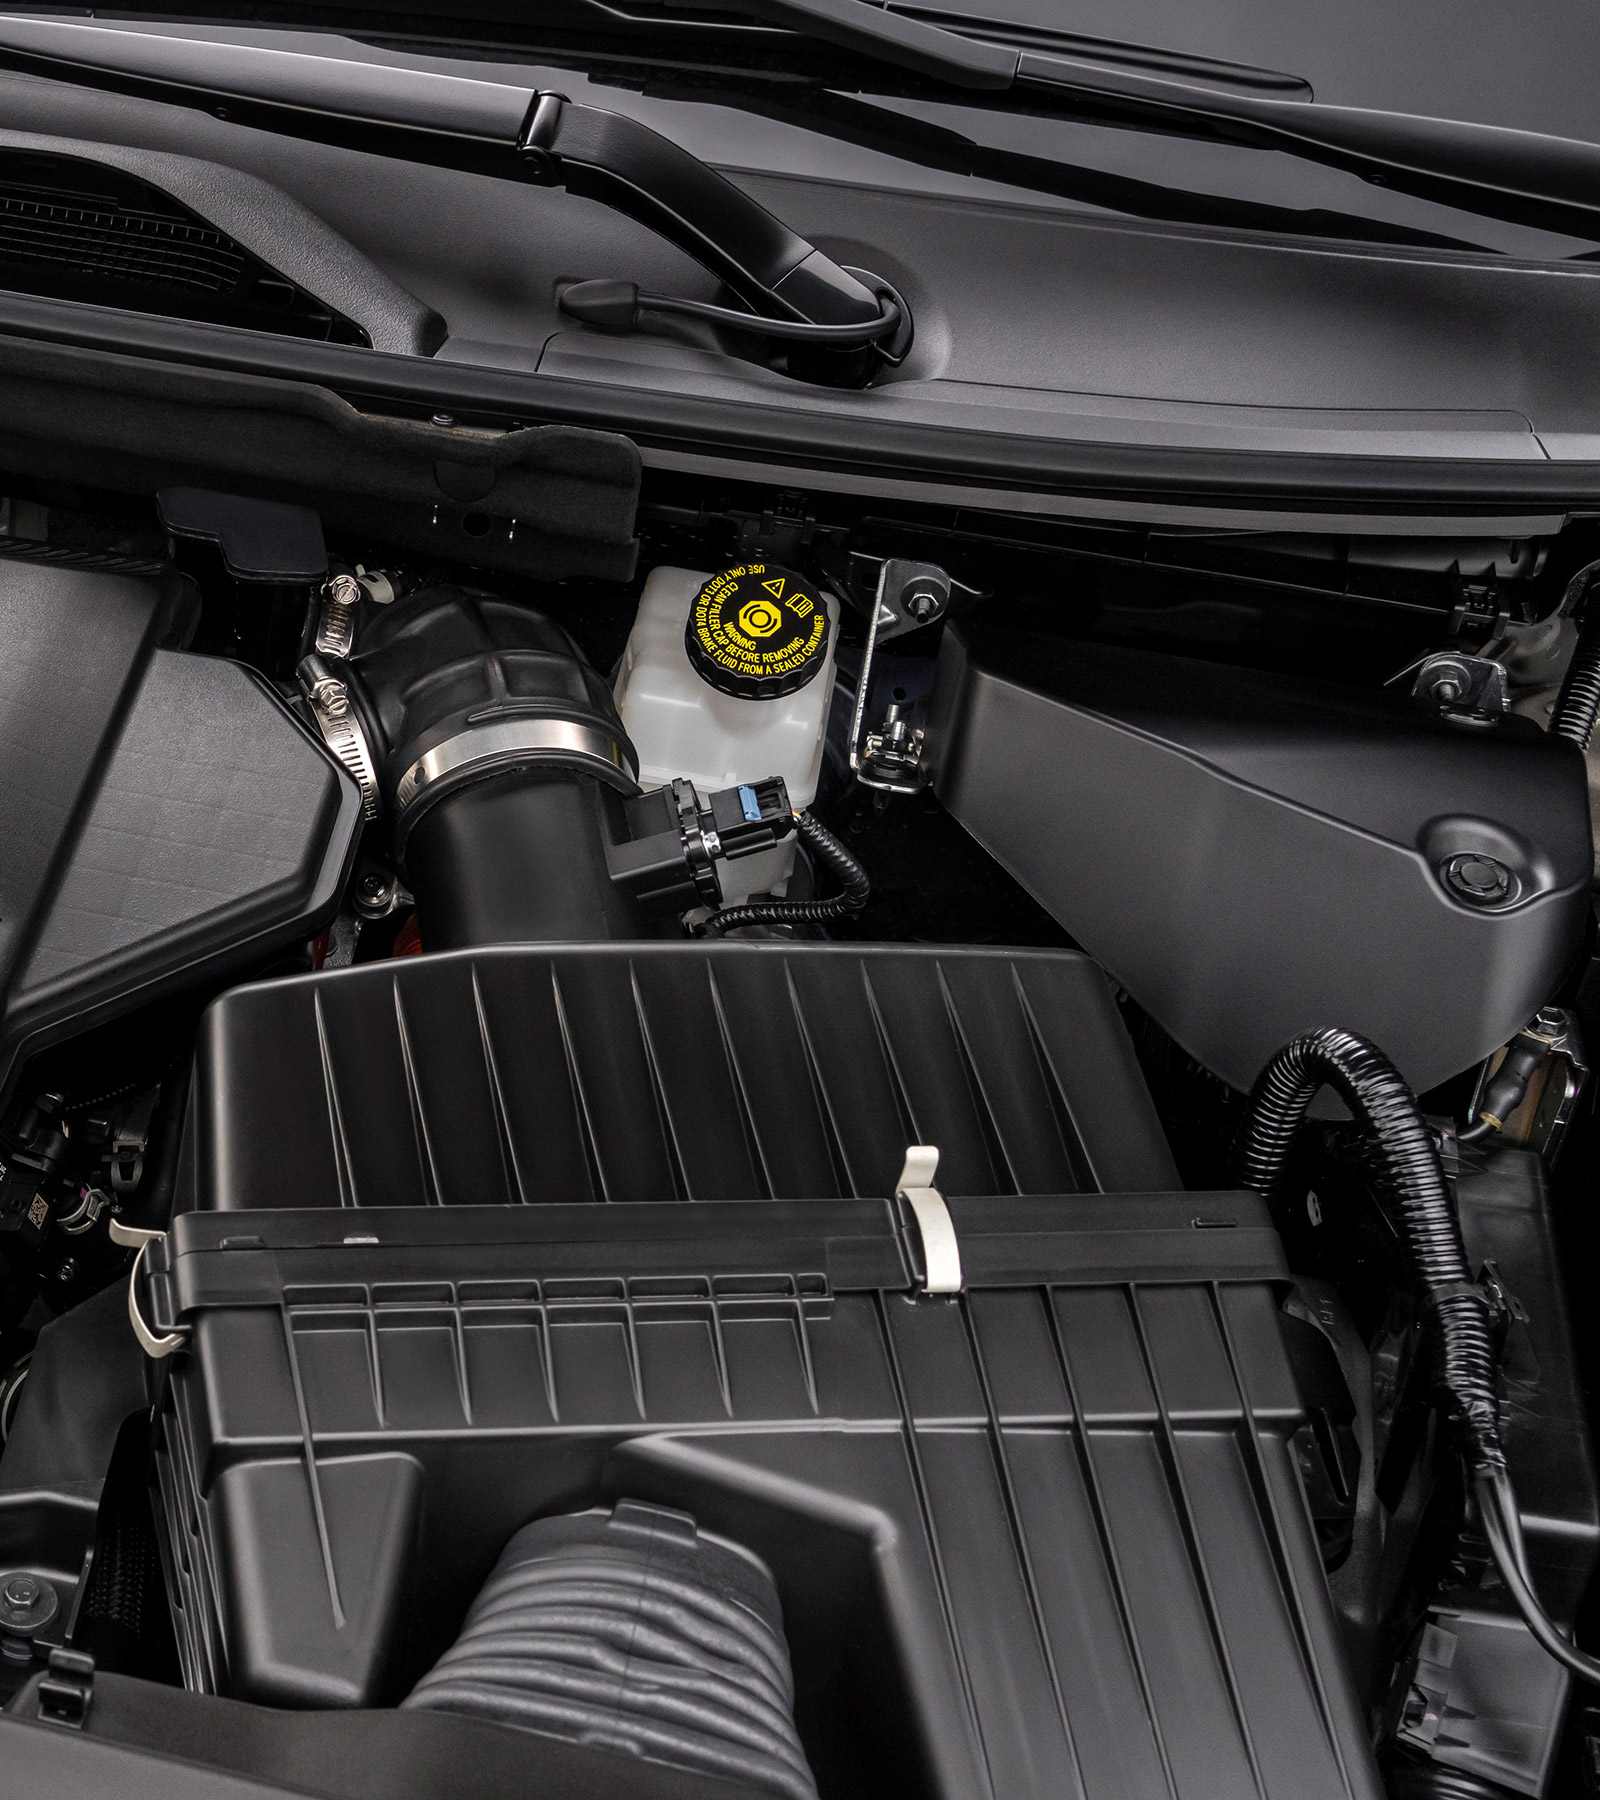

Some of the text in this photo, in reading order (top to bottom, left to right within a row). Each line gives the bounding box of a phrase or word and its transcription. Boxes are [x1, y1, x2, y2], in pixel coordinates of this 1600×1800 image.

[695, 564, 825, 675] USE ONLY DOT3 OR DOT4 BRAKE FLUID FROM A SEALED CONTAINER
[708, 581, 805, 663] CLEAN FILLER CAP BEFORE REMOVING
[723, 621, 757, 651] WARNING
